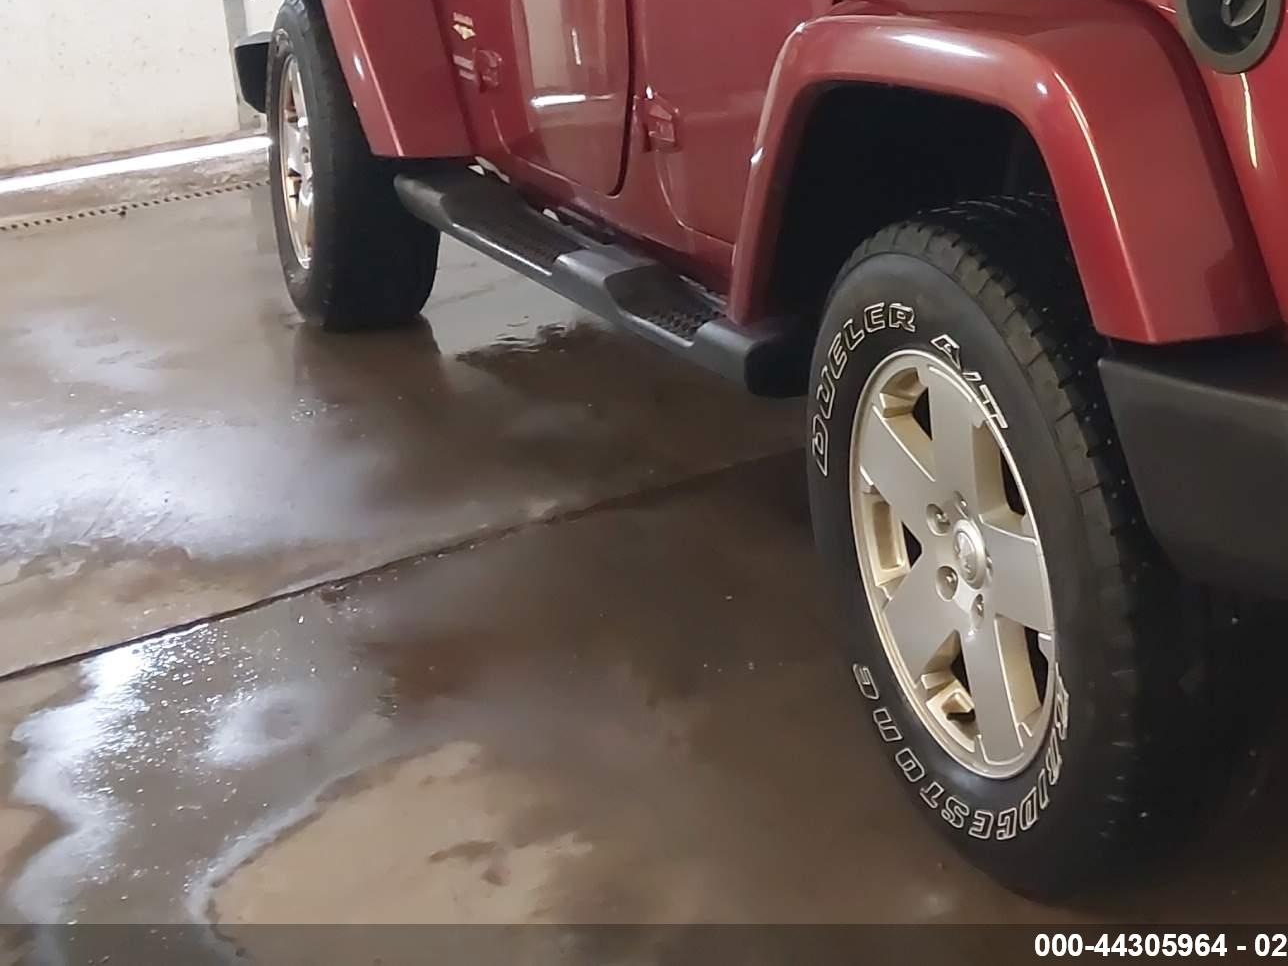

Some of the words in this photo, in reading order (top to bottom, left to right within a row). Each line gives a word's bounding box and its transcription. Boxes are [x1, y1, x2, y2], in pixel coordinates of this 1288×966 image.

[811, 301, 916, 477] DUELER
[930, 333, 1009, 429] A/T
[852, 661, 1070, 841] BRIDGESTONE
